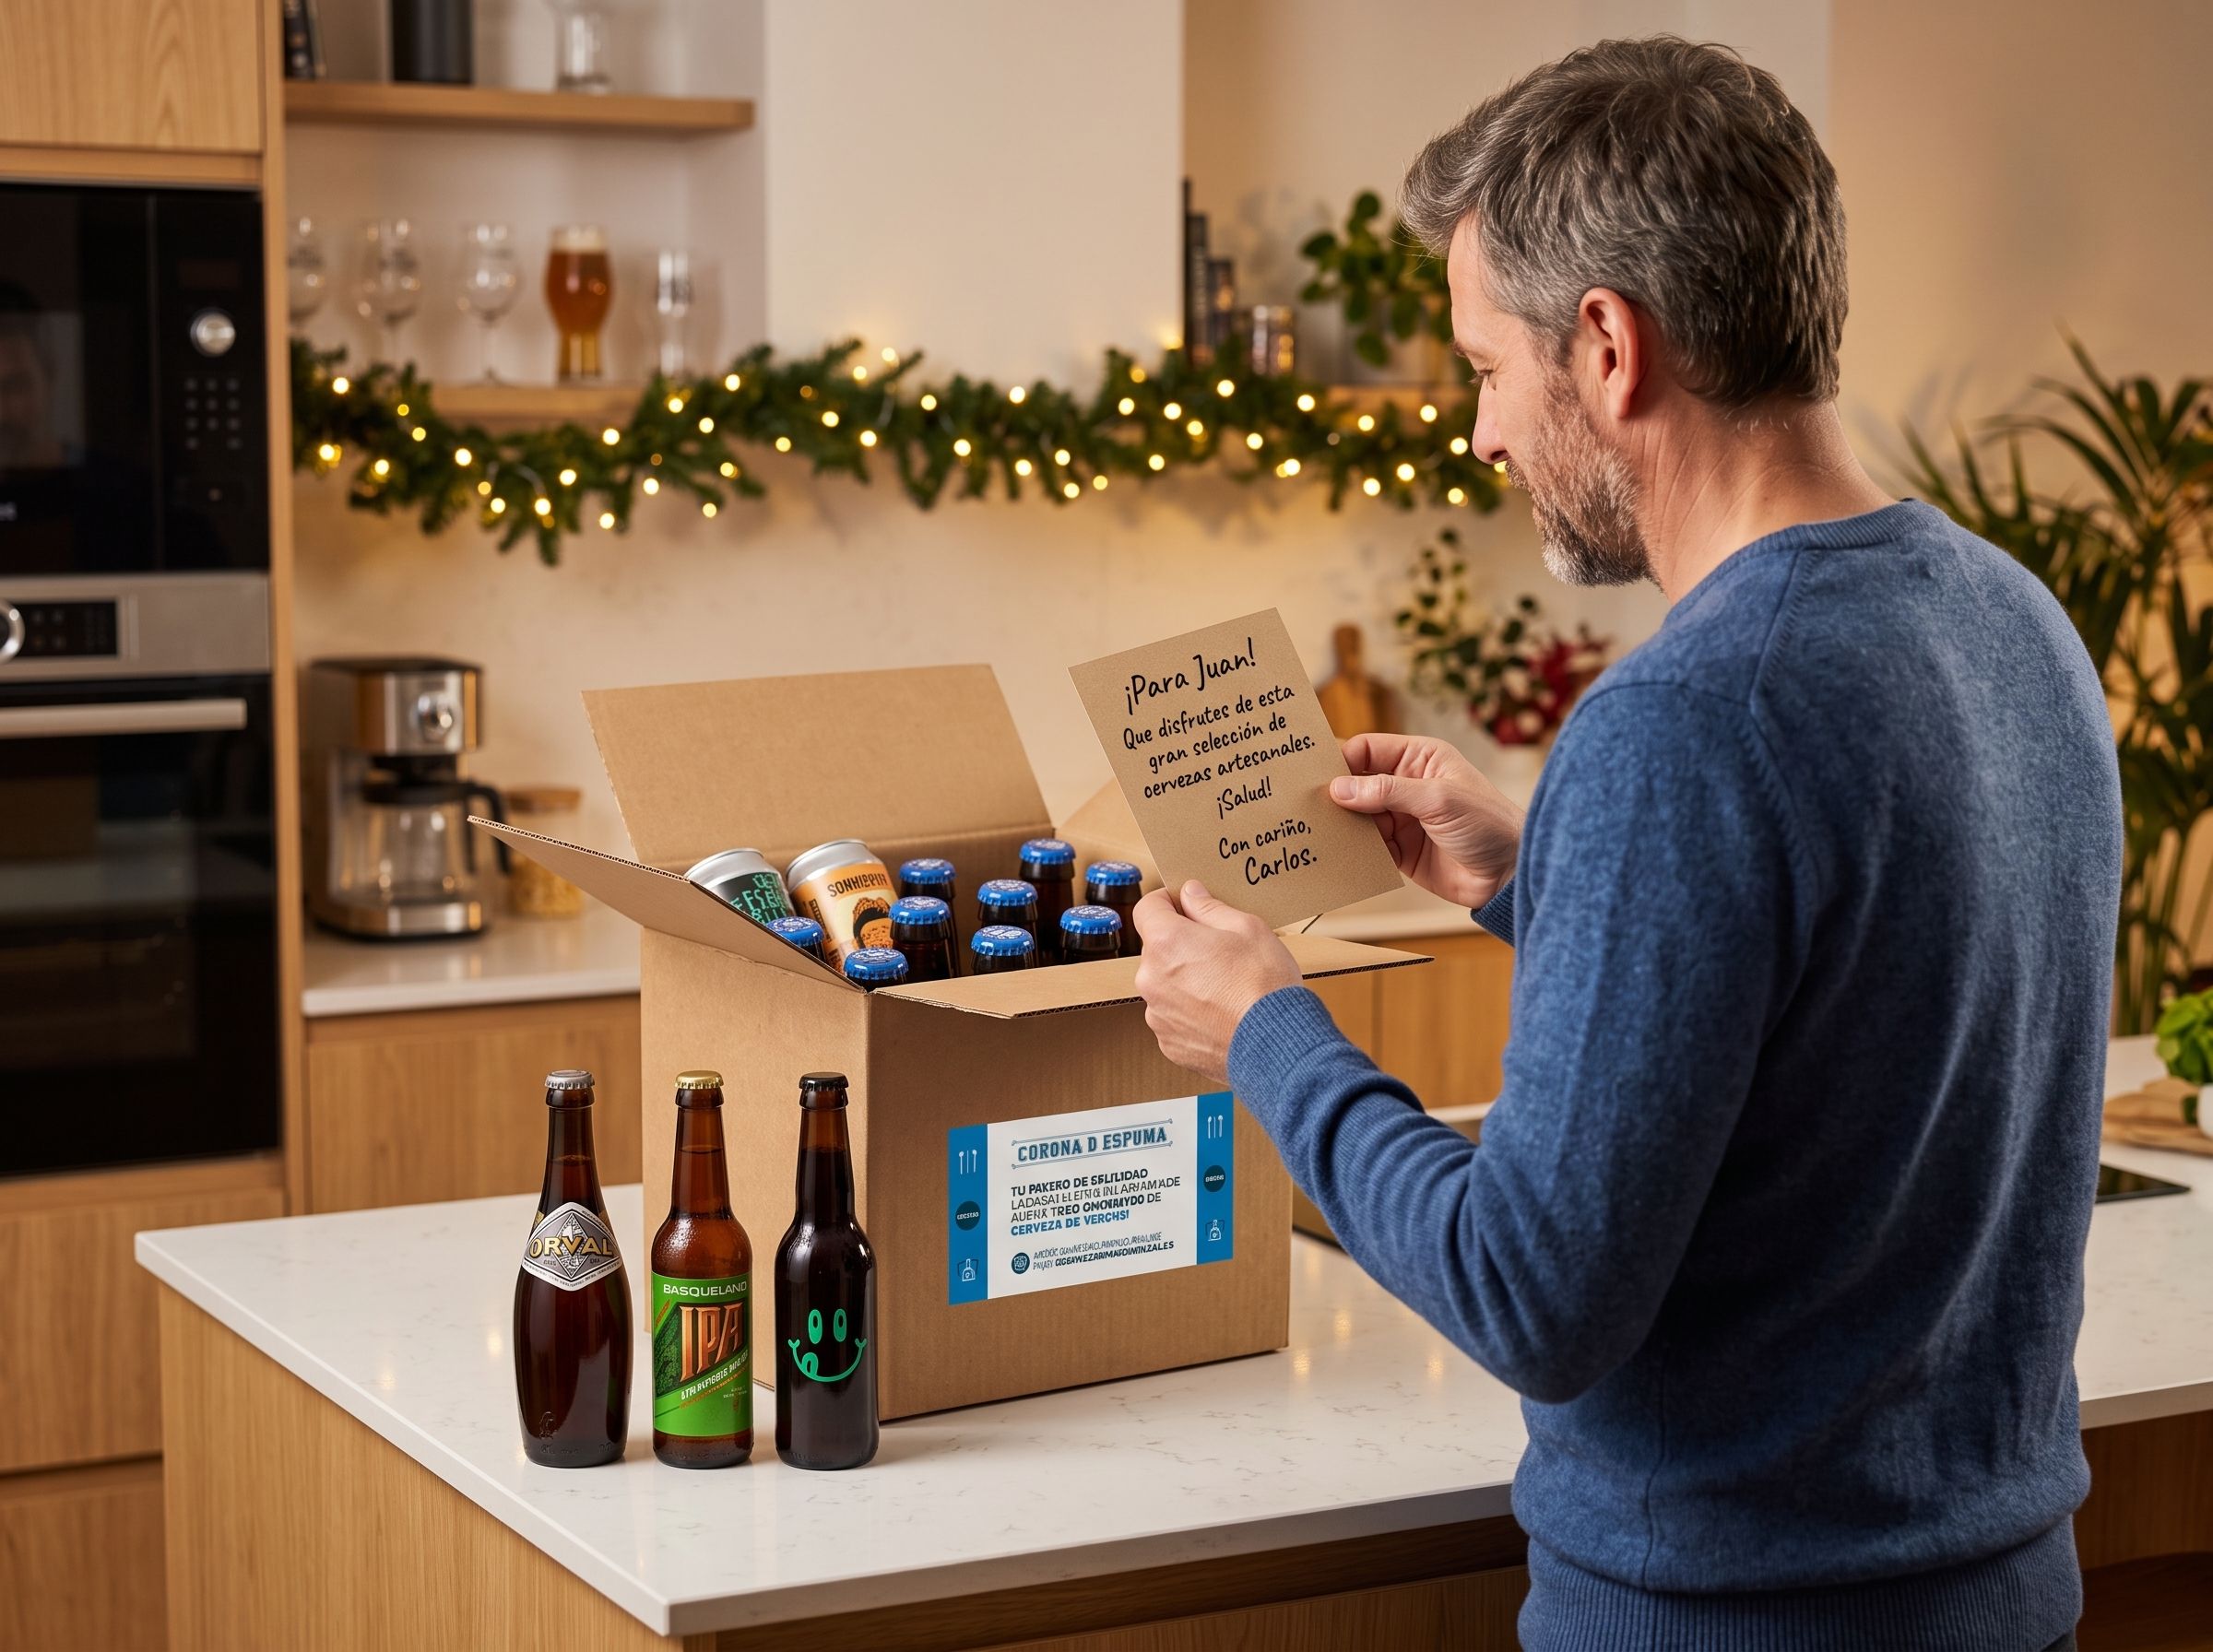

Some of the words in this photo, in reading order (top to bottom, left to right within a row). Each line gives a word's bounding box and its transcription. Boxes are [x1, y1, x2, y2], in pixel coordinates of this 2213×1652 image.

[1125, 670, 1189, 715] ¡Para
[1192, 637, 1257, 691] Juan!
[1123, 727, 1153, 750] Que
[1158, 705, 1230, 738] disfrutes
[1235, 694, 1254, 715] de
[1259, 685, 1296, 707] esta
[1149, 749, 1189, 774] gran
[1193, 724, 1263, 756] selección
[1269, 712, 1287, 731] de
[1217, 733, 1316, 777] artesanales.
[1216, 775, 1273, 820] ¡Salud!
[1218, 836, 1250, 859] Con
[1256, 818, 1312, 846] cariño,
[1244, 846, 1318, 886] Carlos.
[1017, 1138, 1083, 1162] CORONA
[1087, 1135, 1097, 1151] D
[1102, 1127, 1167, 1150] ESPUMA
[1011, 1186, 1025, 1197] TU
[1073, 1176, 1089, 1188] DE
[1050, 1204, 1080, 1217] TREO
[1147, 1192, 1161, 1203] DE
[1011, 1220, 1062, 1235] CERVEZA
[1066, 1217, 1081, 1229] DE
[529, 1235, 614, 1259] ORVAL
[663, 1280, 747, 1298] BASQUELAND
[679, 1302, 743, 1382] IPA
